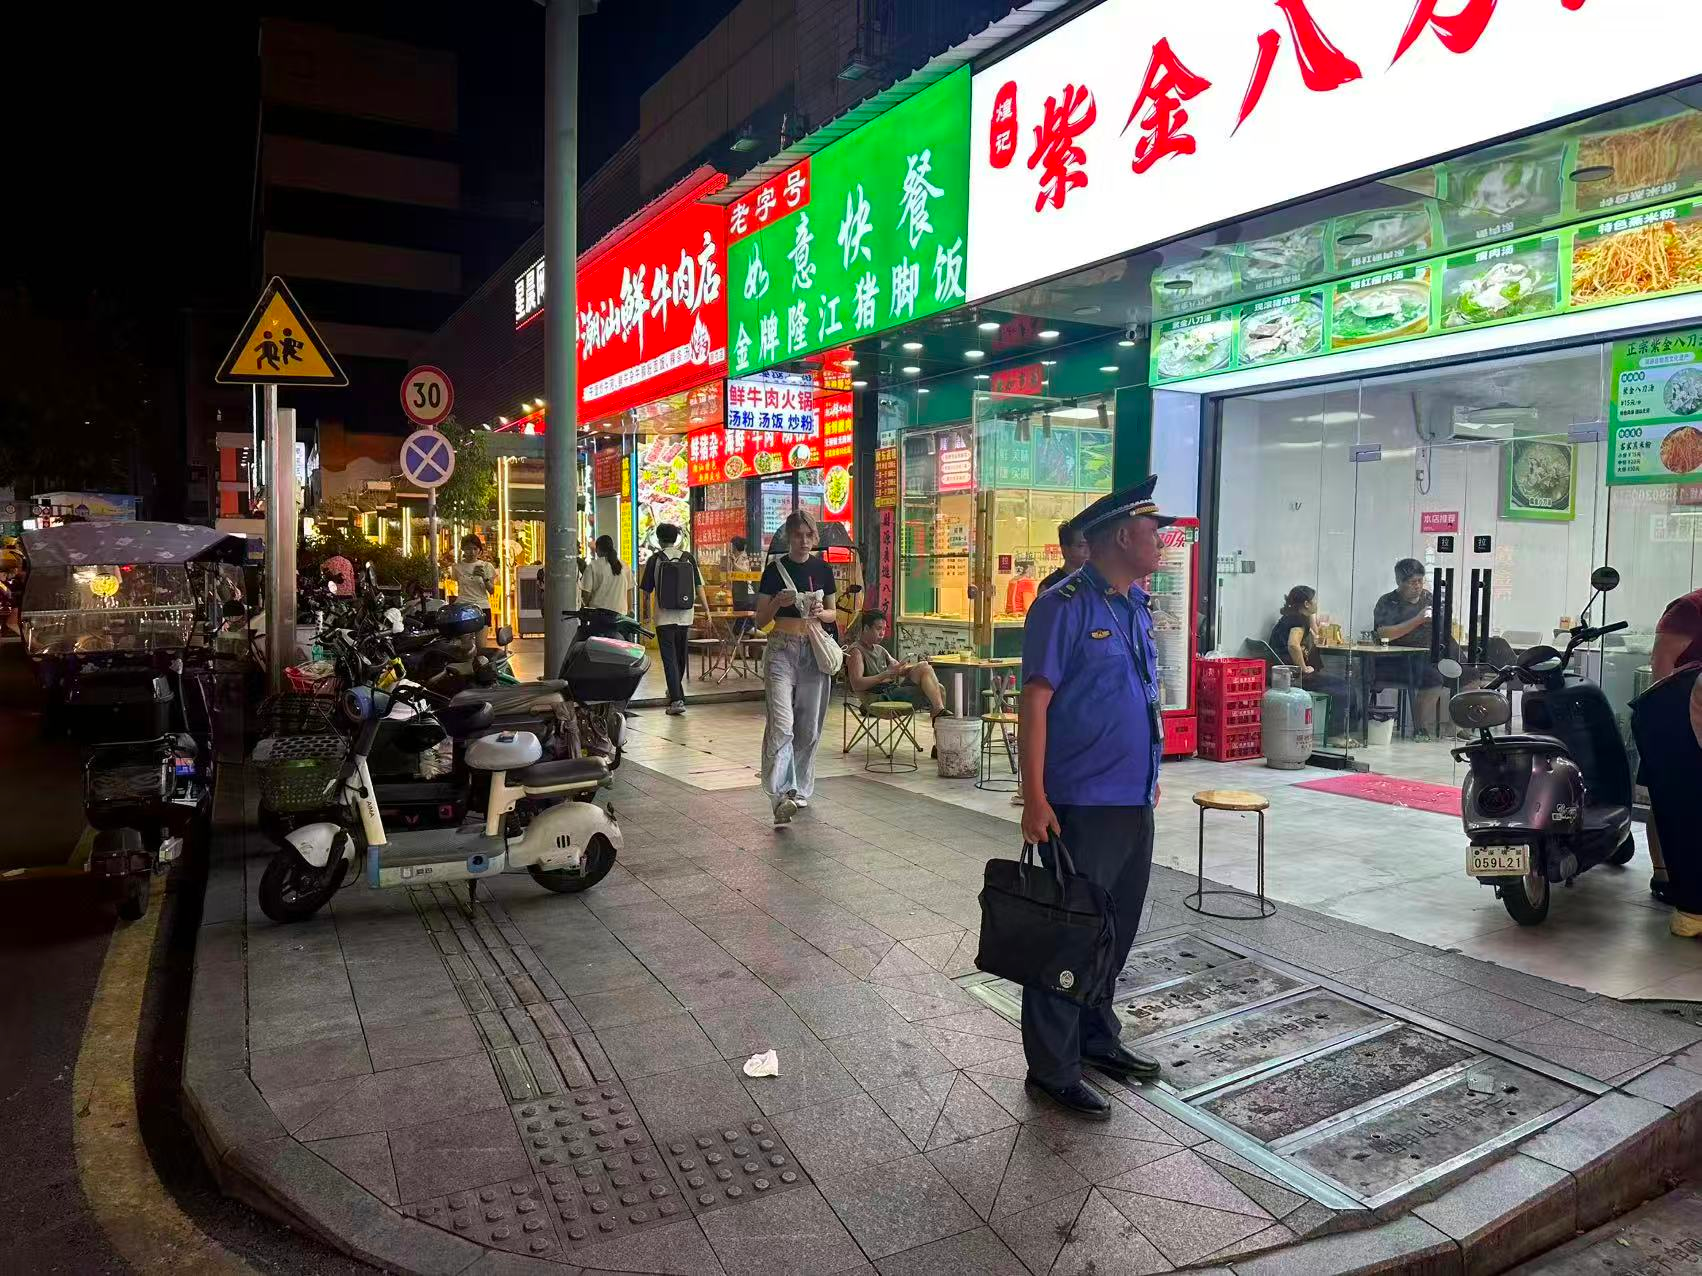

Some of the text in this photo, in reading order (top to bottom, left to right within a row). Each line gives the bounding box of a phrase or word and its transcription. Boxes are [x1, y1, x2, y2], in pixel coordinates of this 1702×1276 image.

[730, 171, 806, 235] 老字号
[743, 149, 945, 300] 如意快餐
[734, 238, 967, 372] 金牌隆江猪脚饭
[1172, 314, 1212, 330] 紫金八刀汤
[413, 382, 441, 409] 30
[729, 384, 814, 412] 鲜牛肉火锅
[729, 410, 754, 427] 汤粉
[758, 413, 783, 429] 汤饭
[788, 414, 813, 431] 炒粉
[1423, 514, 1456, 524] 本店推荐
[1441, 538, 1450, 546] 拉
[1478, 538, 1487, 546] 拉
[366, 800, 375, 818] AIMA
[1474, 857, 1521, 868] 059L21
